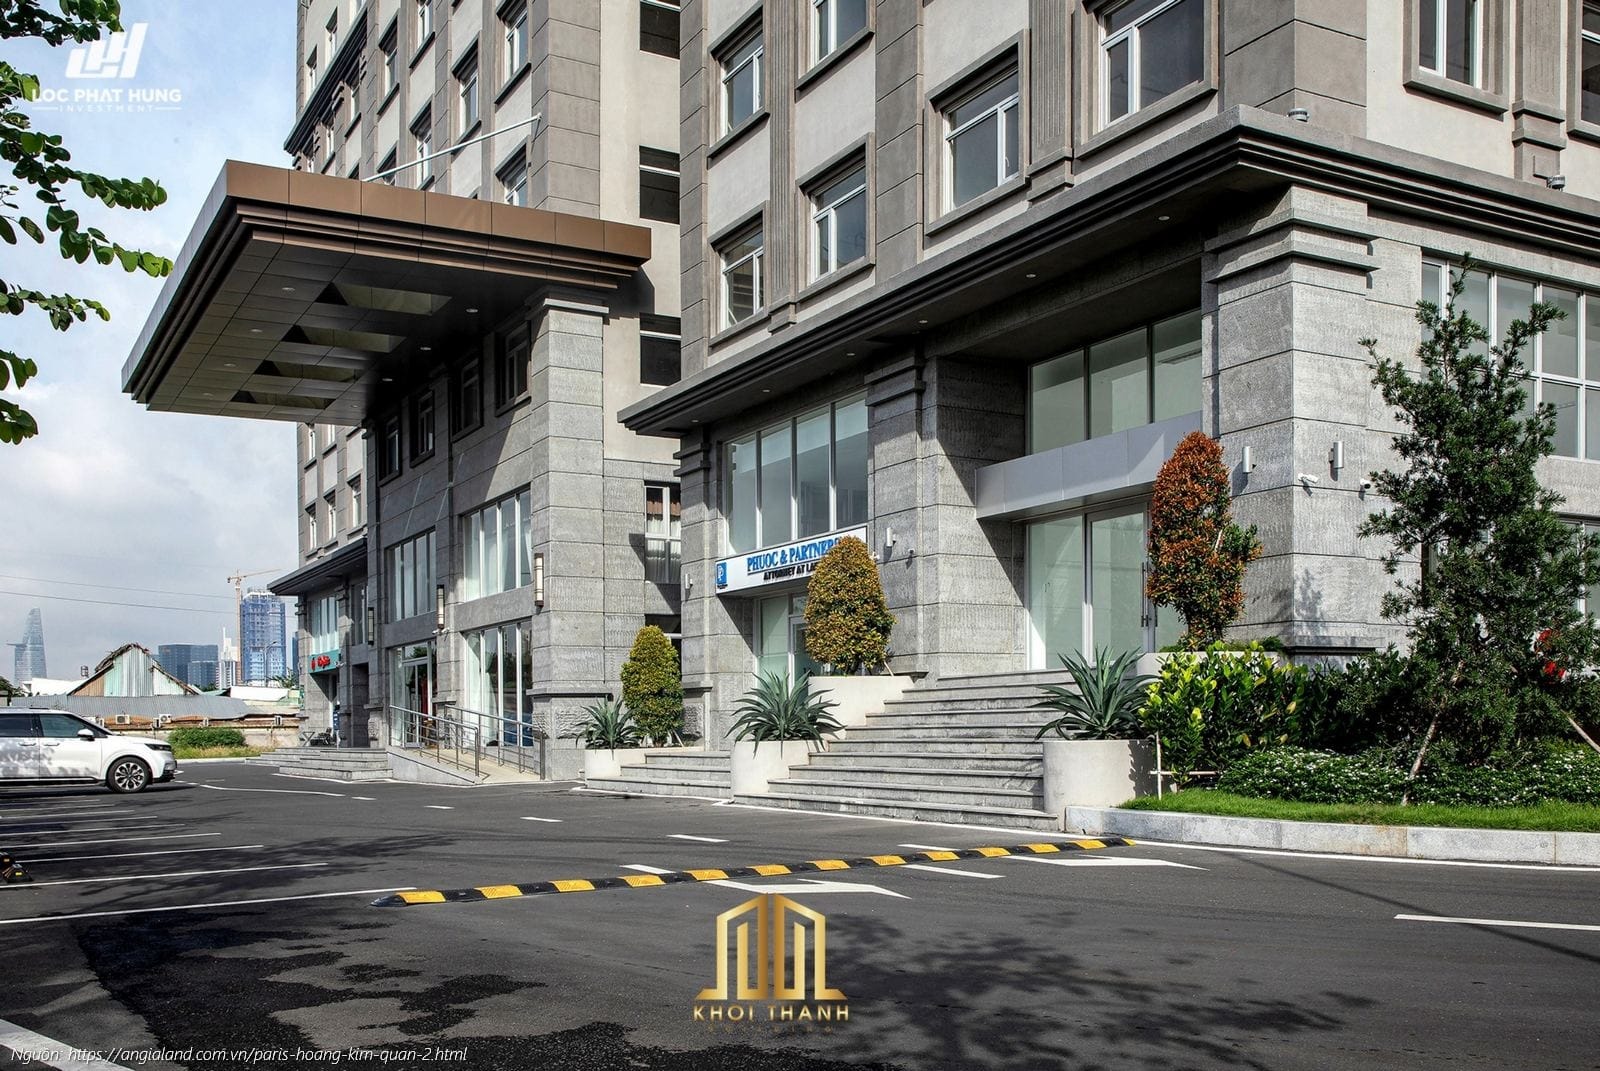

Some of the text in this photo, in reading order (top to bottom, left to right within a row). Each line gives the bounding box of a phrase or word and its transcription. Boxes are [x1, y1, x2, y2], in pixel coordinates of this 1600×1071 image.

[747, 554, 779, 572] PHUOC
[780, 551, 788, 564] &
[763, 566, 795, 580] ATTORNEY
[796, 564, 806, 575] AT
